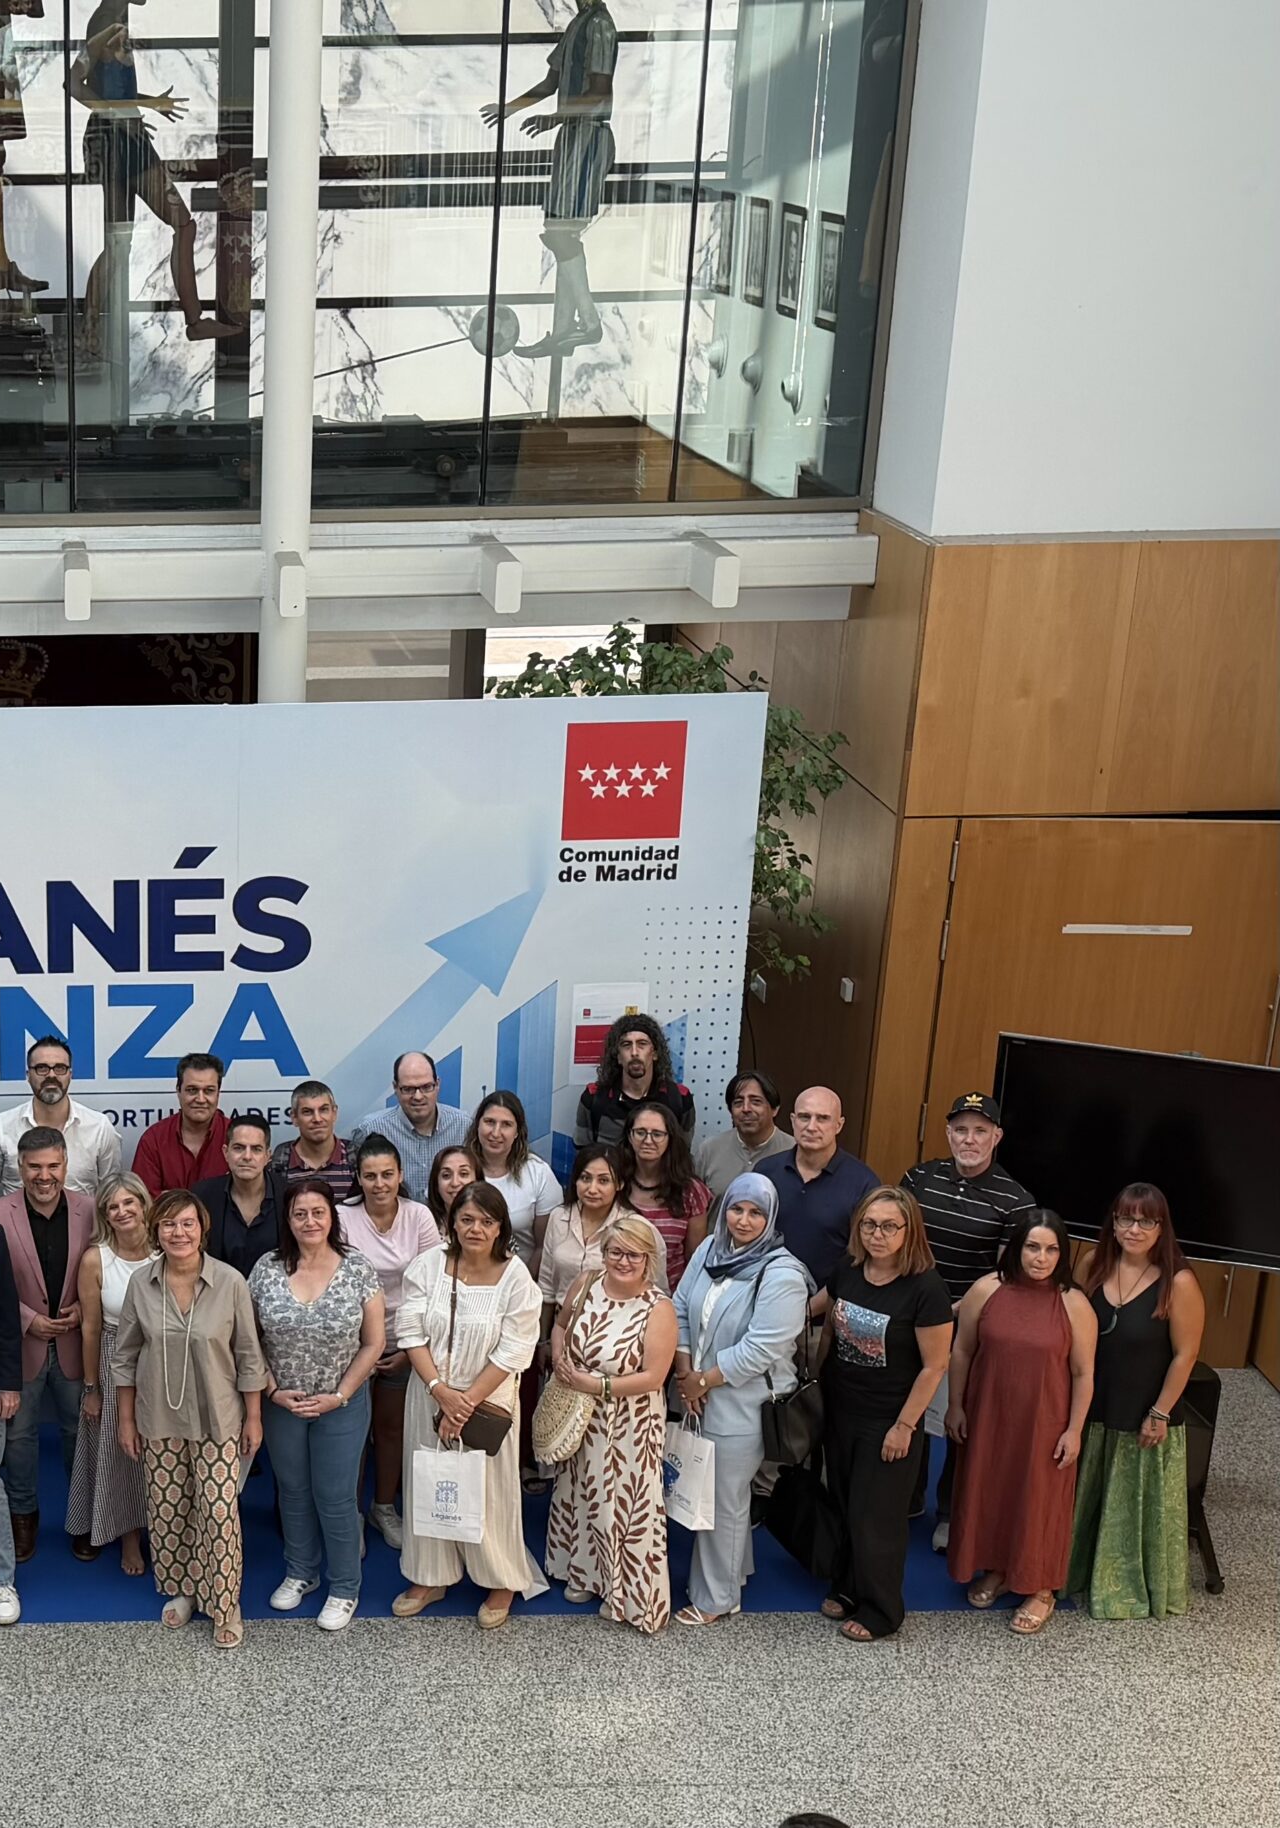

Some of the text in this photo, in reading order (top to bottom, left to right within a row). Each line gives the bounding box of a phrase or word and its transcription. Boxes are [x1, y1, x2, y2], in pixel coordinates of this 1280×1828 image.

[559, 845, 680, 863] Comunidad
[558, 863, 678, 882] de Madrid
